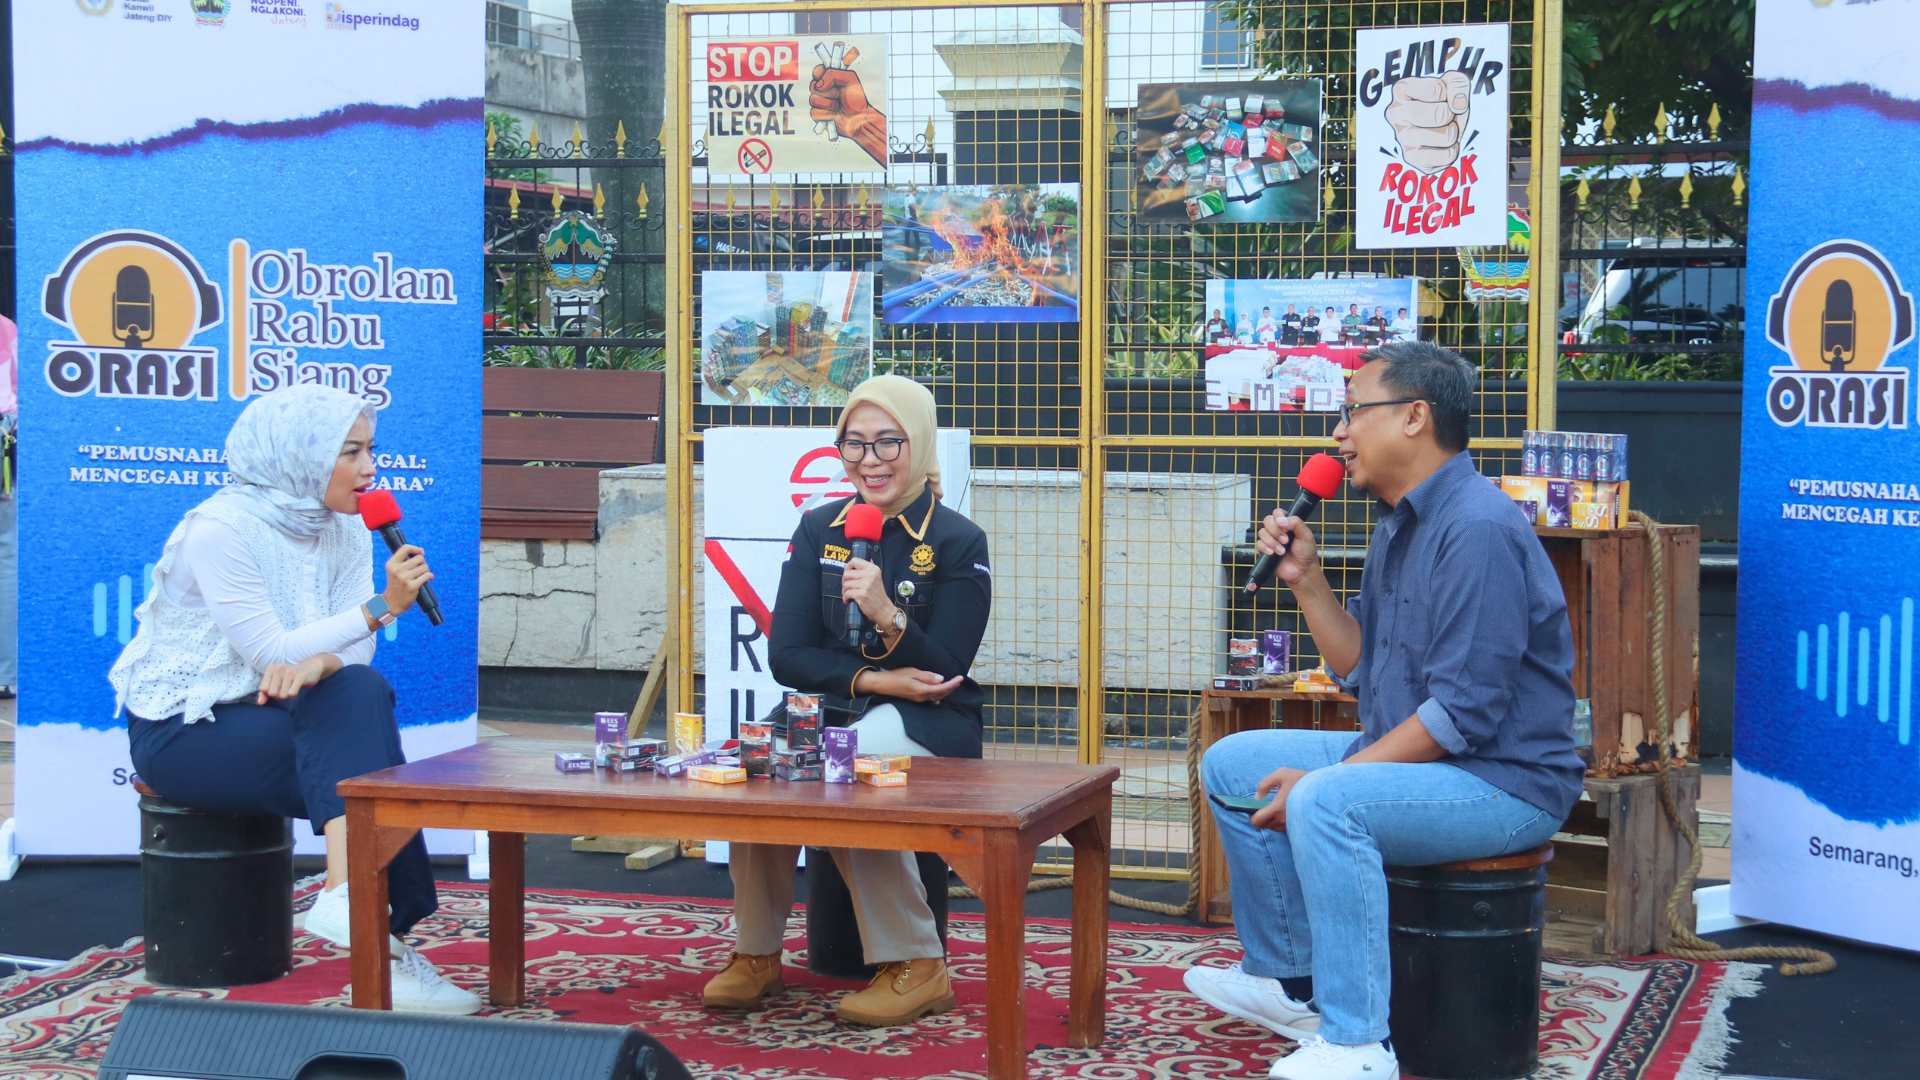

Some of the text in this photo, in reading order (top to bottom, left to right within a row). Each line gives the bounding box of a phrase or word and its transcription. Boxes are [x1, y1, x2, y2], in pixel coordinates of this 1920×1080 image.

[124, 13, 172, 23] Jateng DIY
[709, 46, 793, 78] STOP
[1359, 36, 1504, 108] GEMPUR
[707, 83, 795, 108] ROKOK
[708, 110, 796, 137] ILEGAL
[1379, 153, 1479, 204] ROKOK
[1383, 187, 1475, 235] ILEGAL
[251, 252, 455, 300] Obrolan
[253, 302, 381, 346] Rabu
[48, 350, 215, 396] ORASI
[252, 351, 389, 407] Siang
[1769, 375, 1906, 426] ORASI
[70, 467, 199, 485] MENCEGAH
[1782, 503, 1888, 525] MENCEGAH
[823, 550, 849, 562] LAW
[1808, 836, 1919, 878] Semarang,
